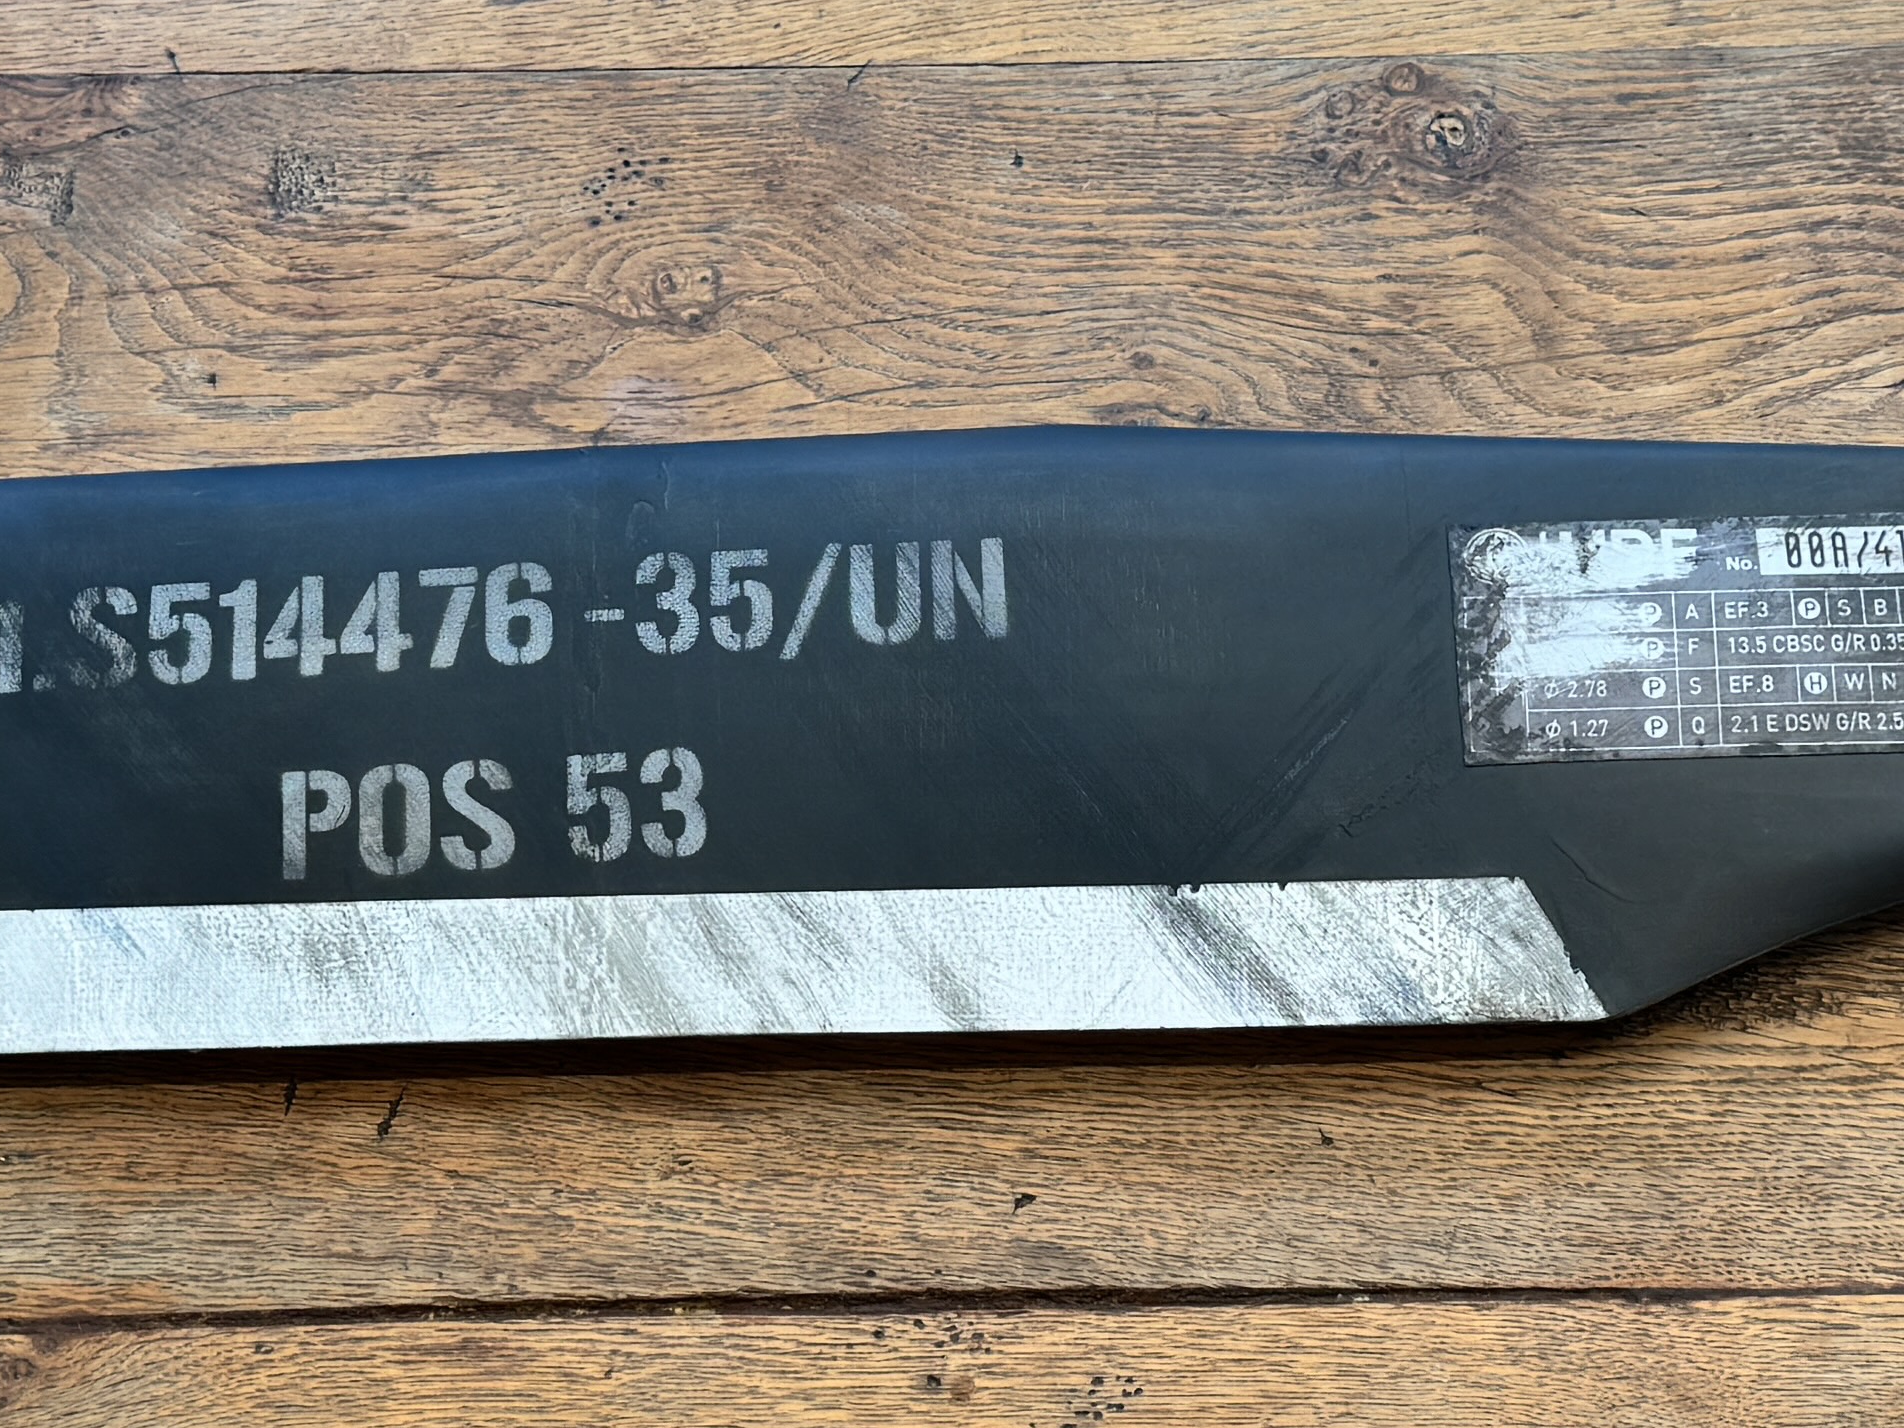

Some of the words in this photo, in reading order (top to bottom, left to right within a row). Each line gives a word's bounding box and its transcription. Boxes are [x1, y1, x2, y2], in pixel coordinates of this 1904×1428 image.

[1726, 557, 1758, 570] No.
[1686, 604, 1699, 620] A
[1837, 600, 1851, 617] S
[1874, 599, 1887, 616] B
[1688, 638, 1699, 655] F
[1728, 636, 1767, 653] 13.5
[1773, 635, 1825, 652] CBSC
[1831, 632, 1866, 652] G/R
[1568, 680, 1607, 698] 2.78
[1690, 677, 1702, 695] S
[1729, 675, 1774, 693] EF.8
[1844, 673, 1864, 690] W
[1881, 672, 1896, 690] N
[1569, 719, 1608, 737] 1.27
[1692, 717, 1704, 735] Q
[1731, 715, 1758, 733] 2.1
[1767, 714, 1778, 732] E
[1785, 713, 1830, 731] DSW
[1837, 711, 1871, 732] G/R
[281, 759, 516, 880] POS
[566, 747, 708, 863] 53
